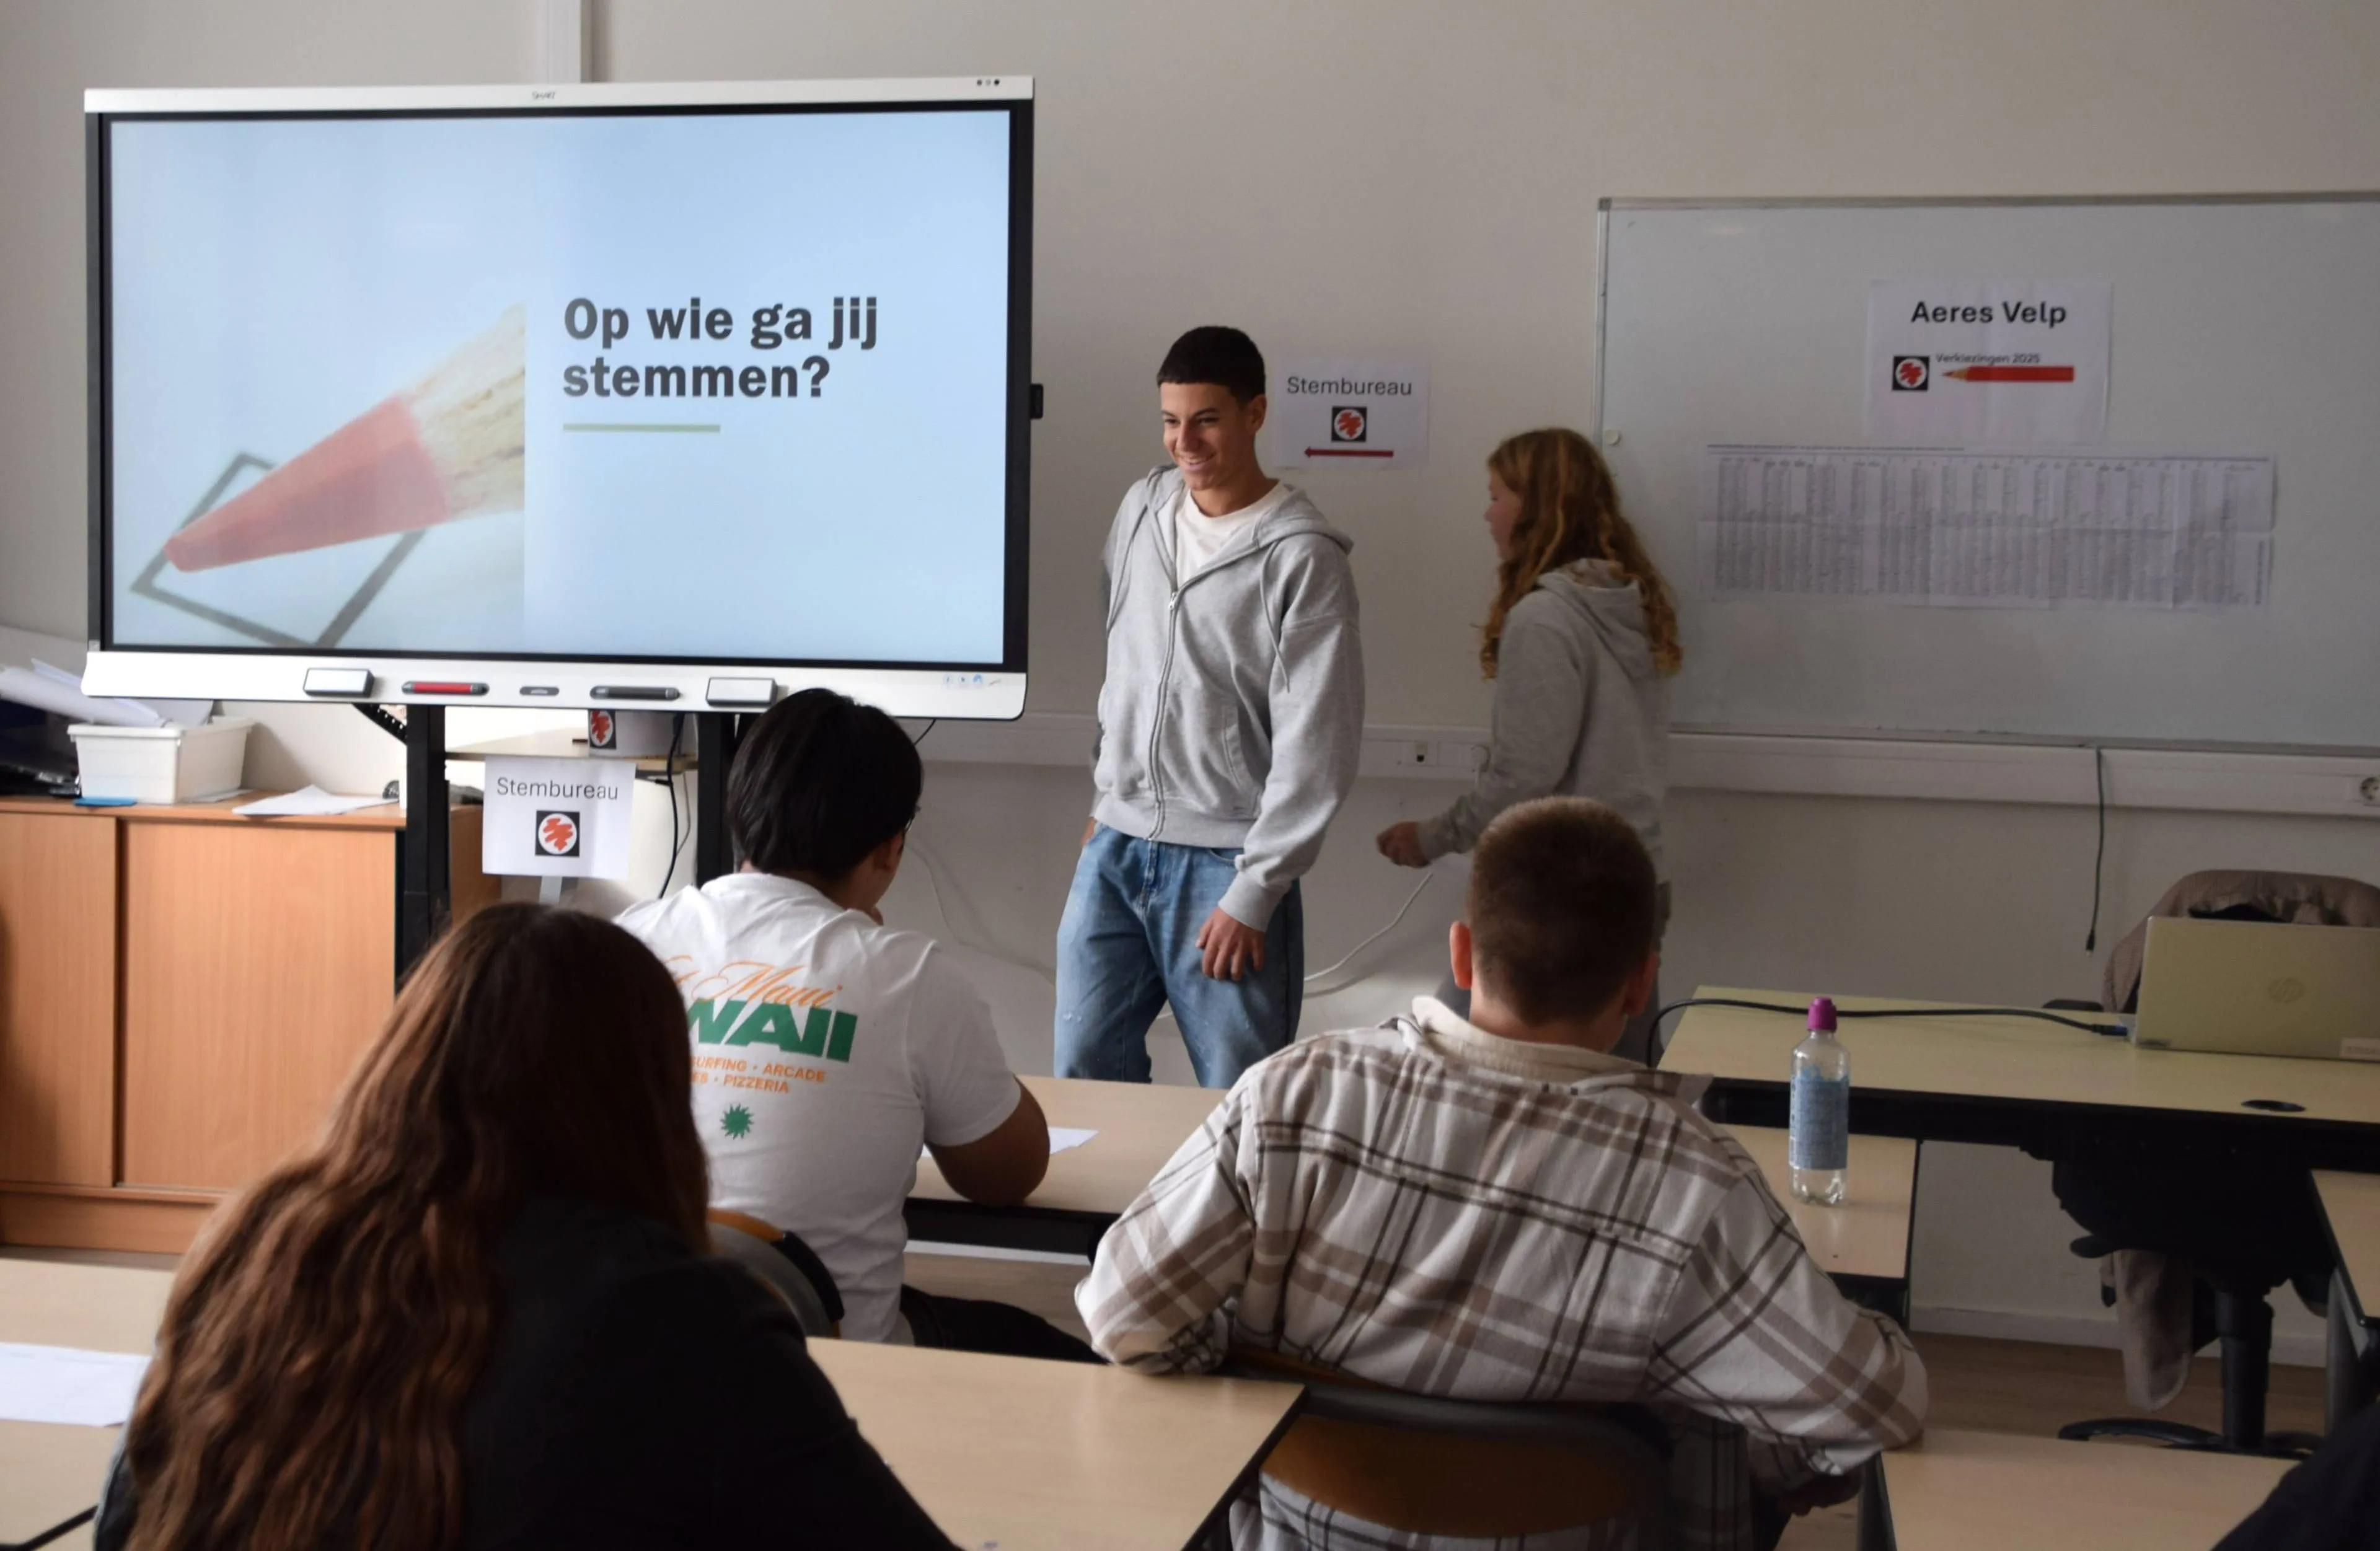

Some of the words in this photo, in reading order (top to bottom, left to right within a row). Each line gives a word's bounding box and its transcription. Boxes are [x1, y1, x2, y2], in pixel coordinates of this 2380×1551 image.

[563, 297, 628, 349] Op
[646, 297, 733, 340] wie
[750, 303, 812, 350] ga
[828, 296, 878, 351] jij
[1911, 301, 1993, 323] Aeres
[2002, 301, 2068, 328] Velp
[1936, 353, 2010, 366] Verkiezingen
[2012, 353, 2040, 364] 2025
[563, 355, 831, 398] stemmen?
[1287, 376, 1413, 395] Stembureau
[497, 776, 618, 801] Stembureau
[691, 959, 843, 1008] Maui
[686, 996, 858, 1063] WAII
[724, 1074, 790, 1094] PIZZERIA
[762, 1061, 827, 1083] ARCADE
